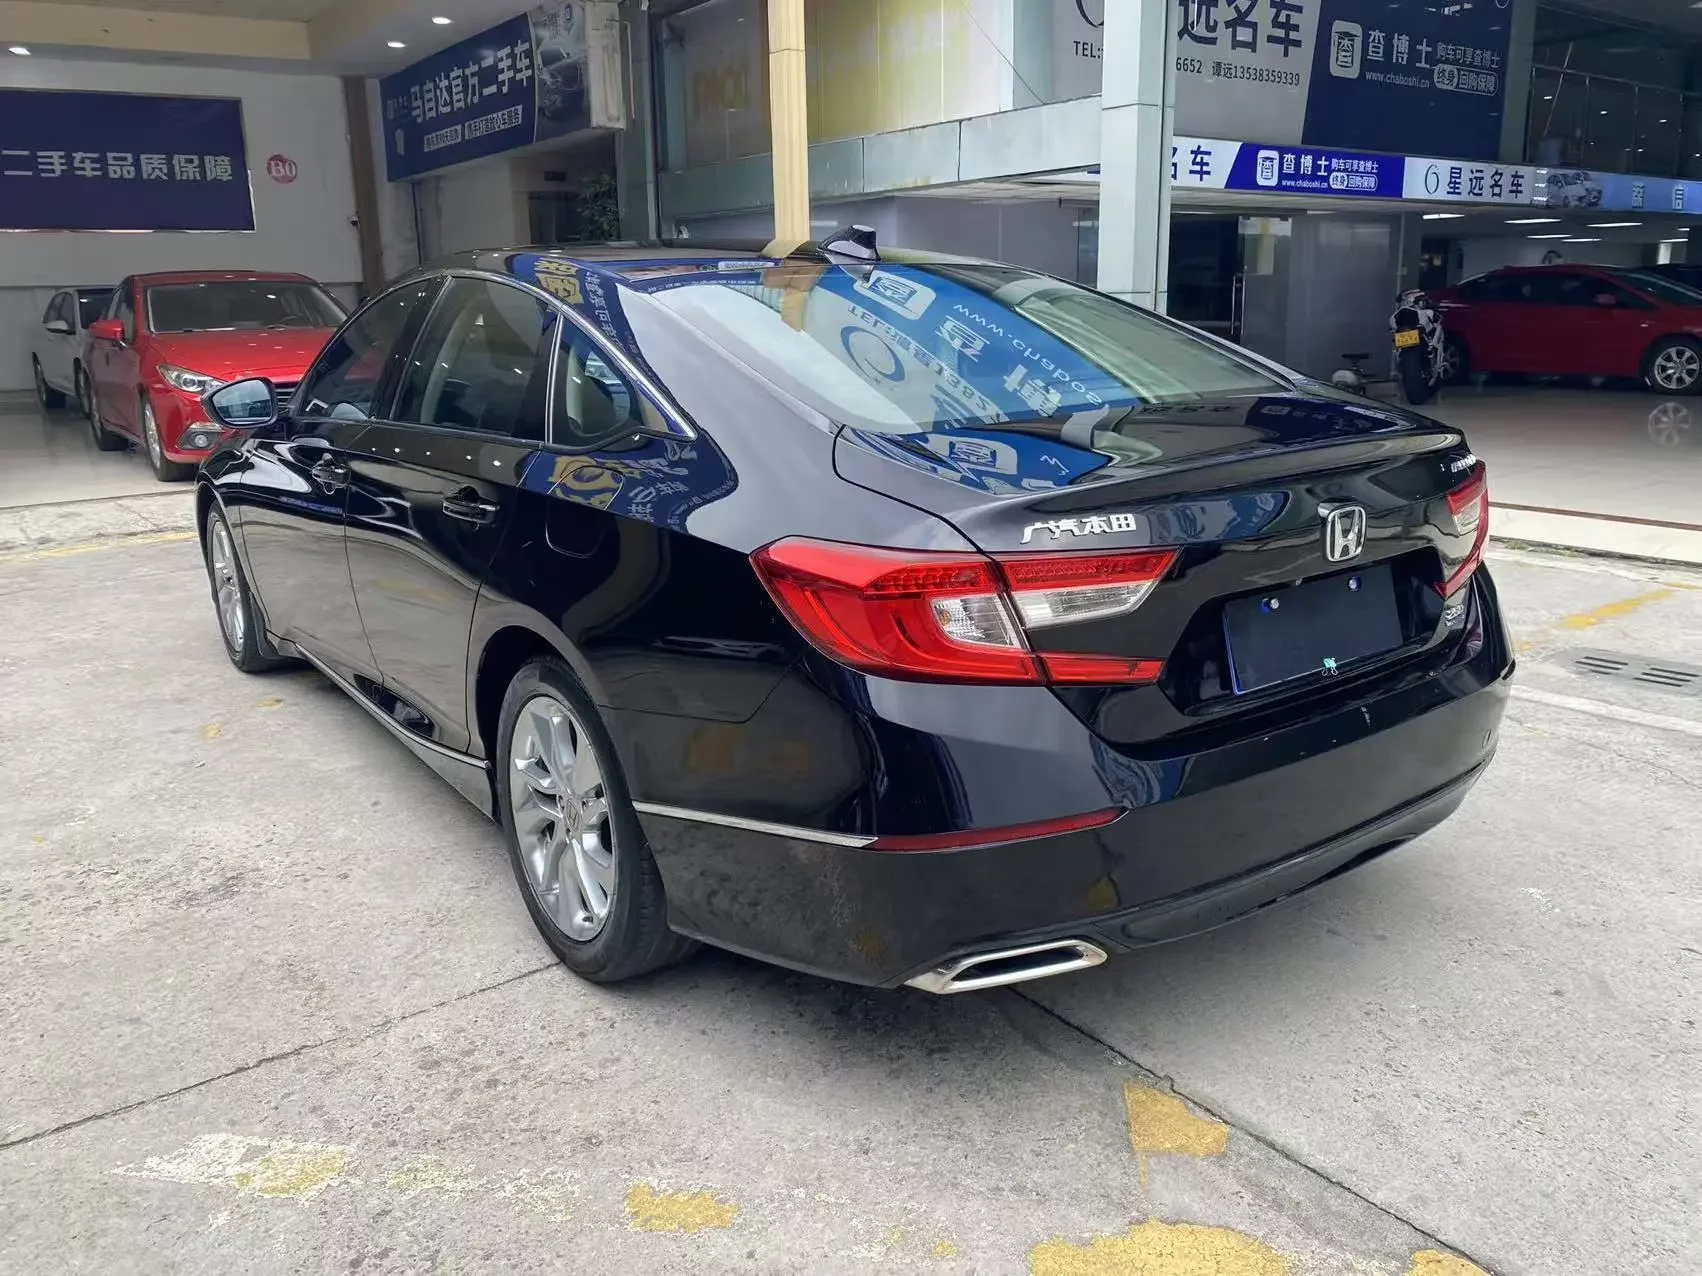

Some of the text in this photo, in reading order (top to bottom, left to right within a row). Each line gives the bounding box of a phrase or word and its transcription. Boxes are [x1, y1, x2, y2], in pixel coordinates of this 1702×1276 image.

[1366, 30, 1432, 68] 查博士
[1365, 70, 1430, 89] www.chaboshi.cn
[1, 150, 233, 181] 二手车品质保障
[1282, 153, 1329, 176] 查博士
[1446, 166, 1525, 199] 星远名车
[1020, 513, 1137, 544] 广汽本田
